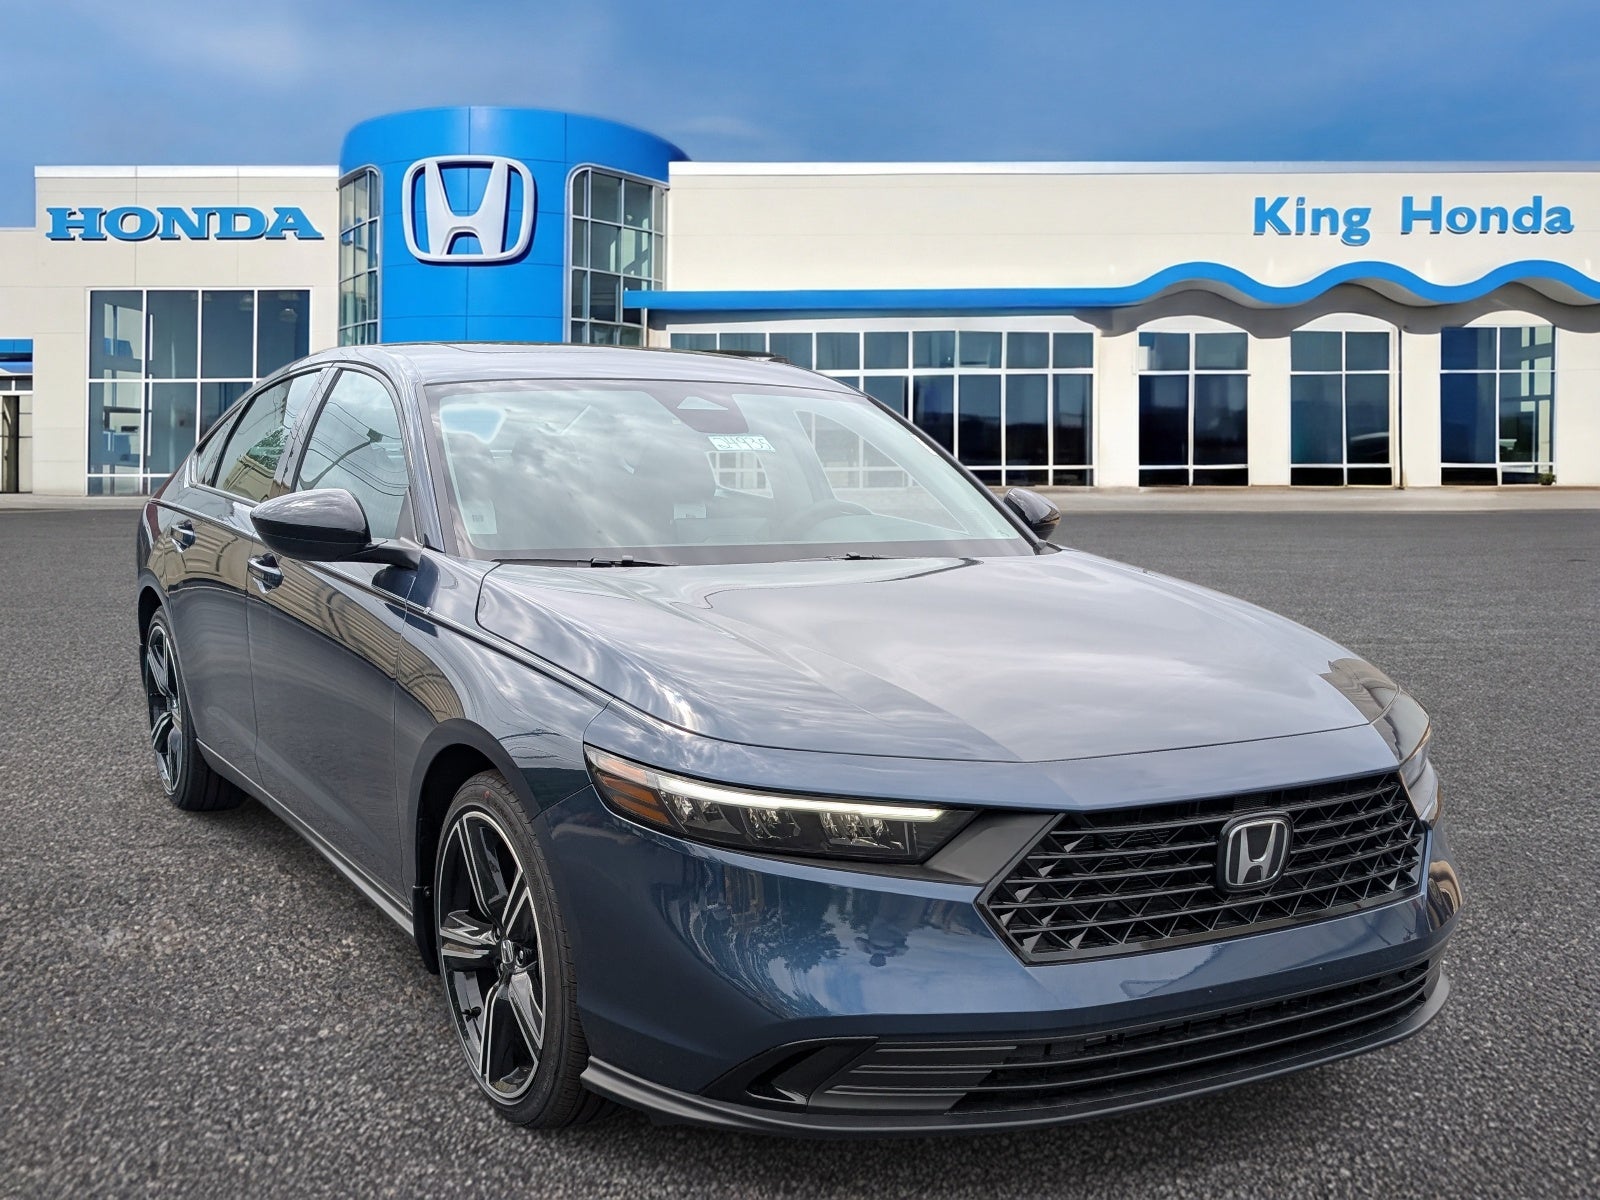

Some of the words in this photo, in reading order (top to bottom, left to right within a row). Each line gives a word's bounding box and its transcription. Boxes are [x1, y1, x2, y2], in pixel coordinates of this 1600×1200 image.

[46, 206, 325, 241] HONDA
[1253, 196, 1372, 246] King
[1401, 195, 1575, 235] Honda
